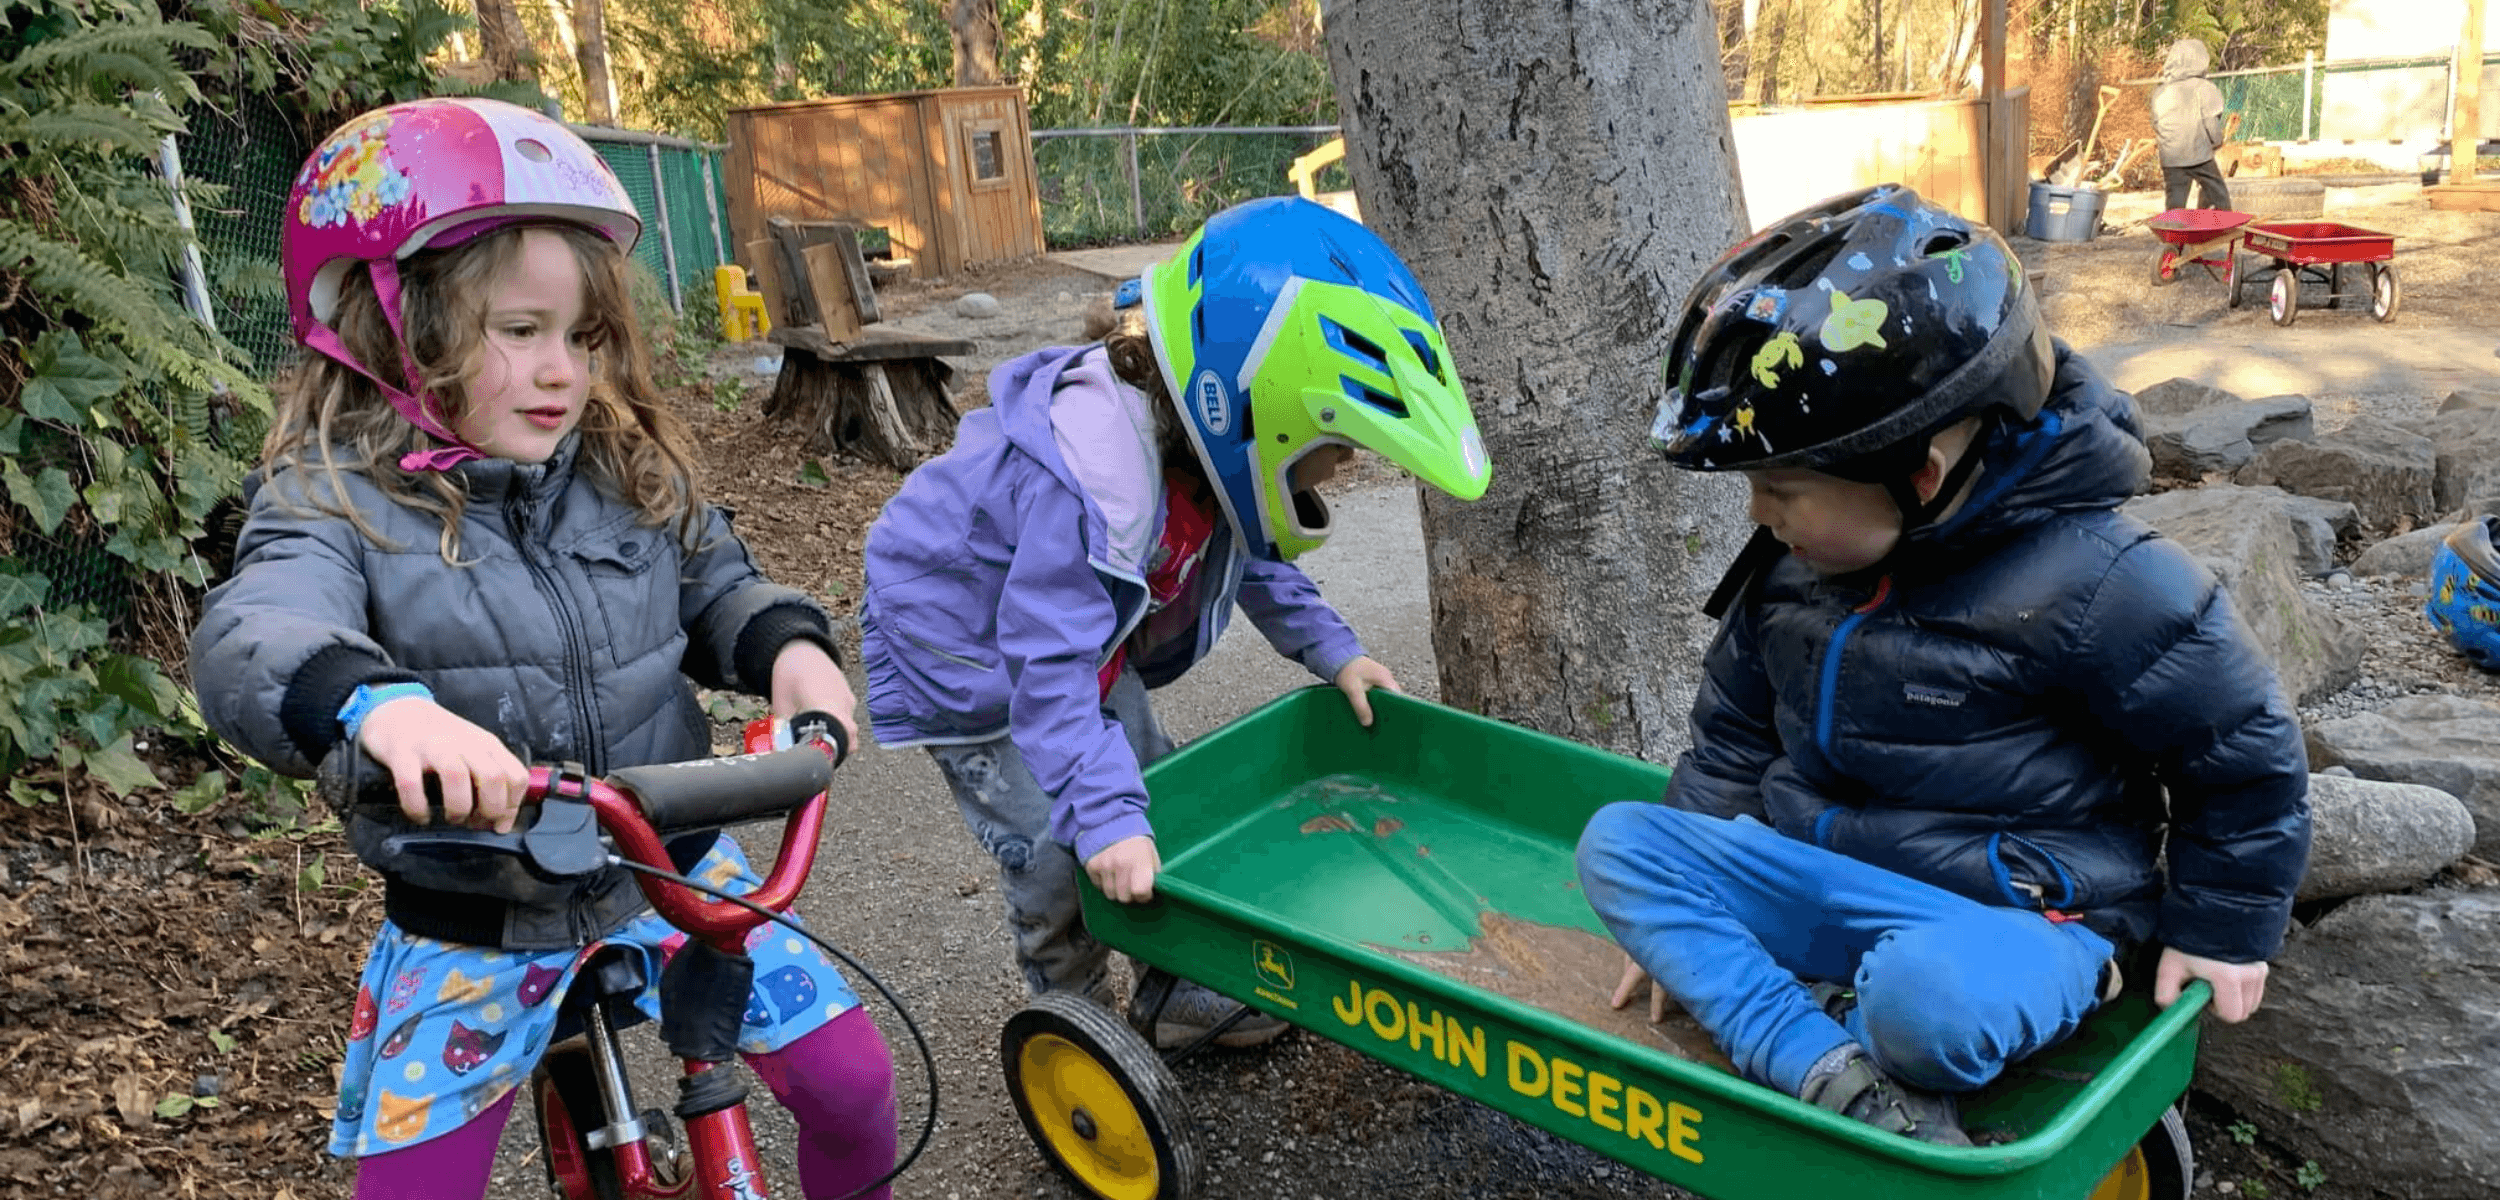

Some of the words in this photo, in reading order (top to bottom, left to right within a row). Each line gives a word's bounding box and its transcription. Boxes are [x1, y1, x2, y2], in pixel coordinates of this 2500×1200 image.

[1203, 382, 1222, 426] BELL
[1906, 691, 1960, 707] patagonia
[1332, 979, 1487, 1078] JOHN
[1507, 1039, 1704, 1164] DEERE
